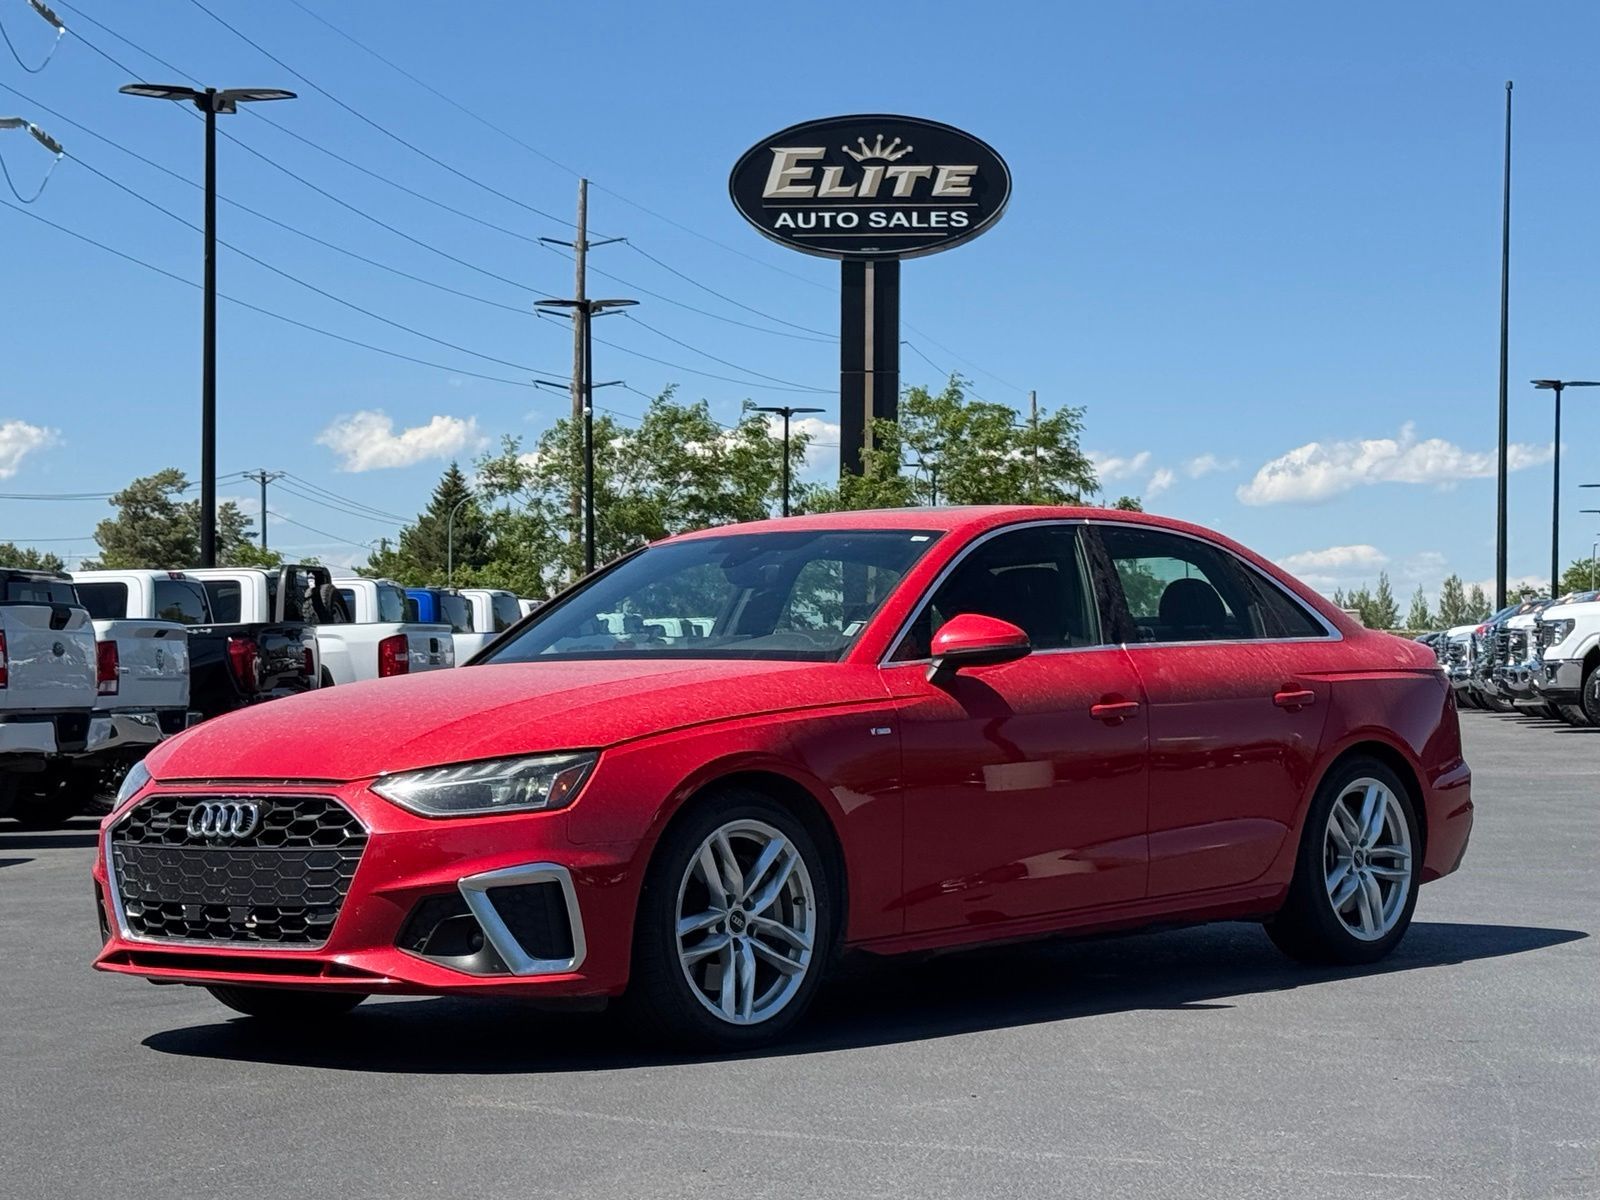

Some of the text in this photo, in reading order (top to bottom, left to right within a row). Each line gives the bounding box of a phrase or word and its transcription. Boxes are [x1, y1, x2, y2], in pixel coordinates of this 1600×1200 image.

[761, 147, 979, 198] ELITE
[774, 211, 969, 229] AUTO SALES
